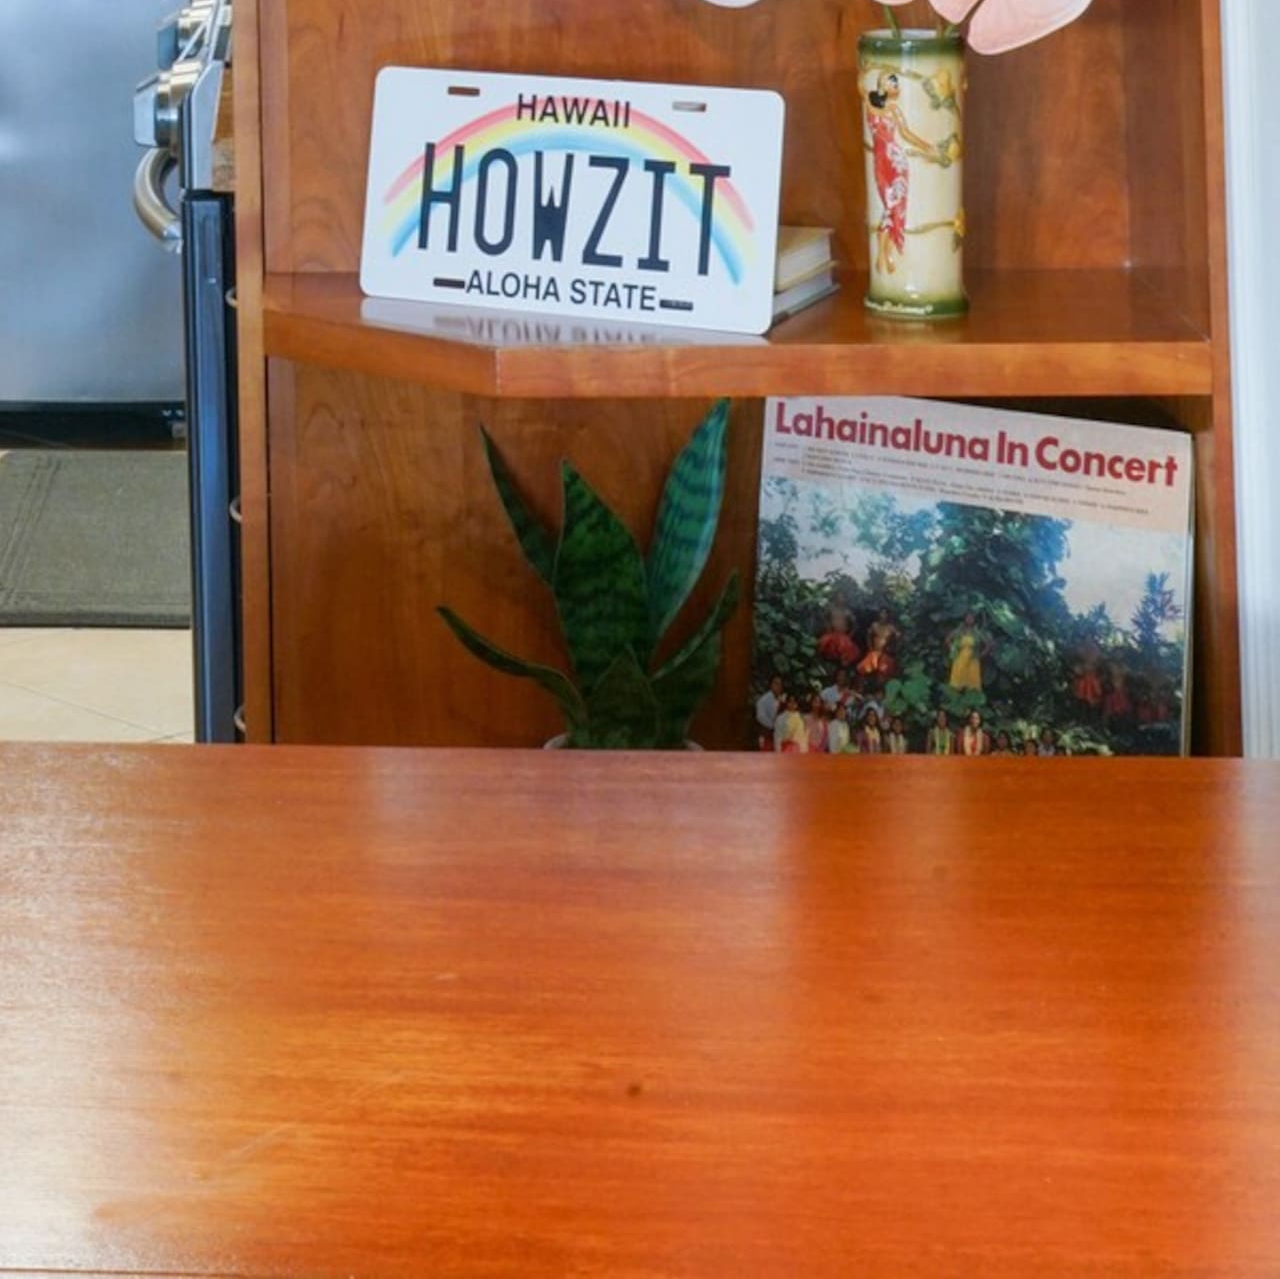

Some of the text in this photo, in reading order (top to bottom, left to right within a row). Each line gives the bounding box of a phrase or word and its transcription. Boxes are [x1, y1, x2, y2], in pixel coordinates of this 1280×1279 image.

[516, 93, 631, 128] HAWAII
[417, 142, 731, 276] HOWZIT
[465, 270, 656, 311] ALOHA STATE
[775, 401, 990, 464] Lahainaluna
[996, 431, 1029, 466] In
[1035, 436, 1179, 487] Concert
